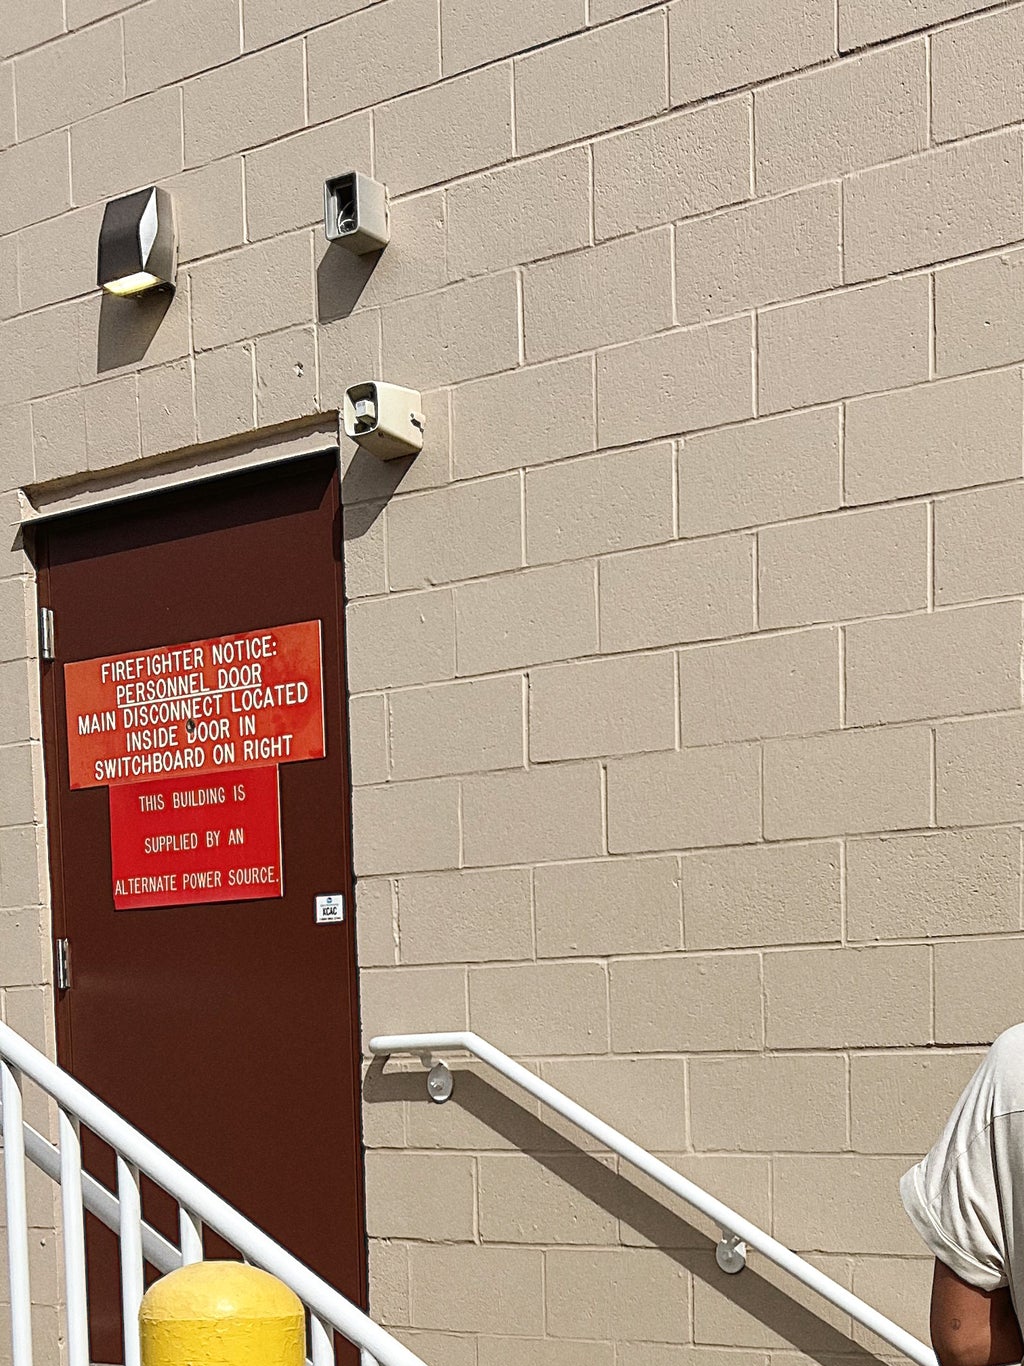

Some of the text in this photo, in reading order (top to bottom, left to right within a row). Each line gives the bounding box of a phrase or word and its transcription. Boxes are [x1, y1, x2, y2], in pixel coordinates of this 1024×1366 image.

[101, 635, 277, 683] FIREFIGHTER NOTICE:
[116, 663, 262, 706] PERSONNEL DOOR
[78, 681, 309, 735] MAIN DISCONNECT LOCATED
[126, 725, 178, 752] INSIDE
[239, 714, 256, 735] IN
[94, 734, 293, 781] SWITCHBOARD ON RIGHT
[138, 784, 246, 812] THIS BUILDING IS
[144, 827, 244, 854] SUPPLIED BY AN
[115, 866, 279, 896] ALTERNATE POWER SOURCE.
